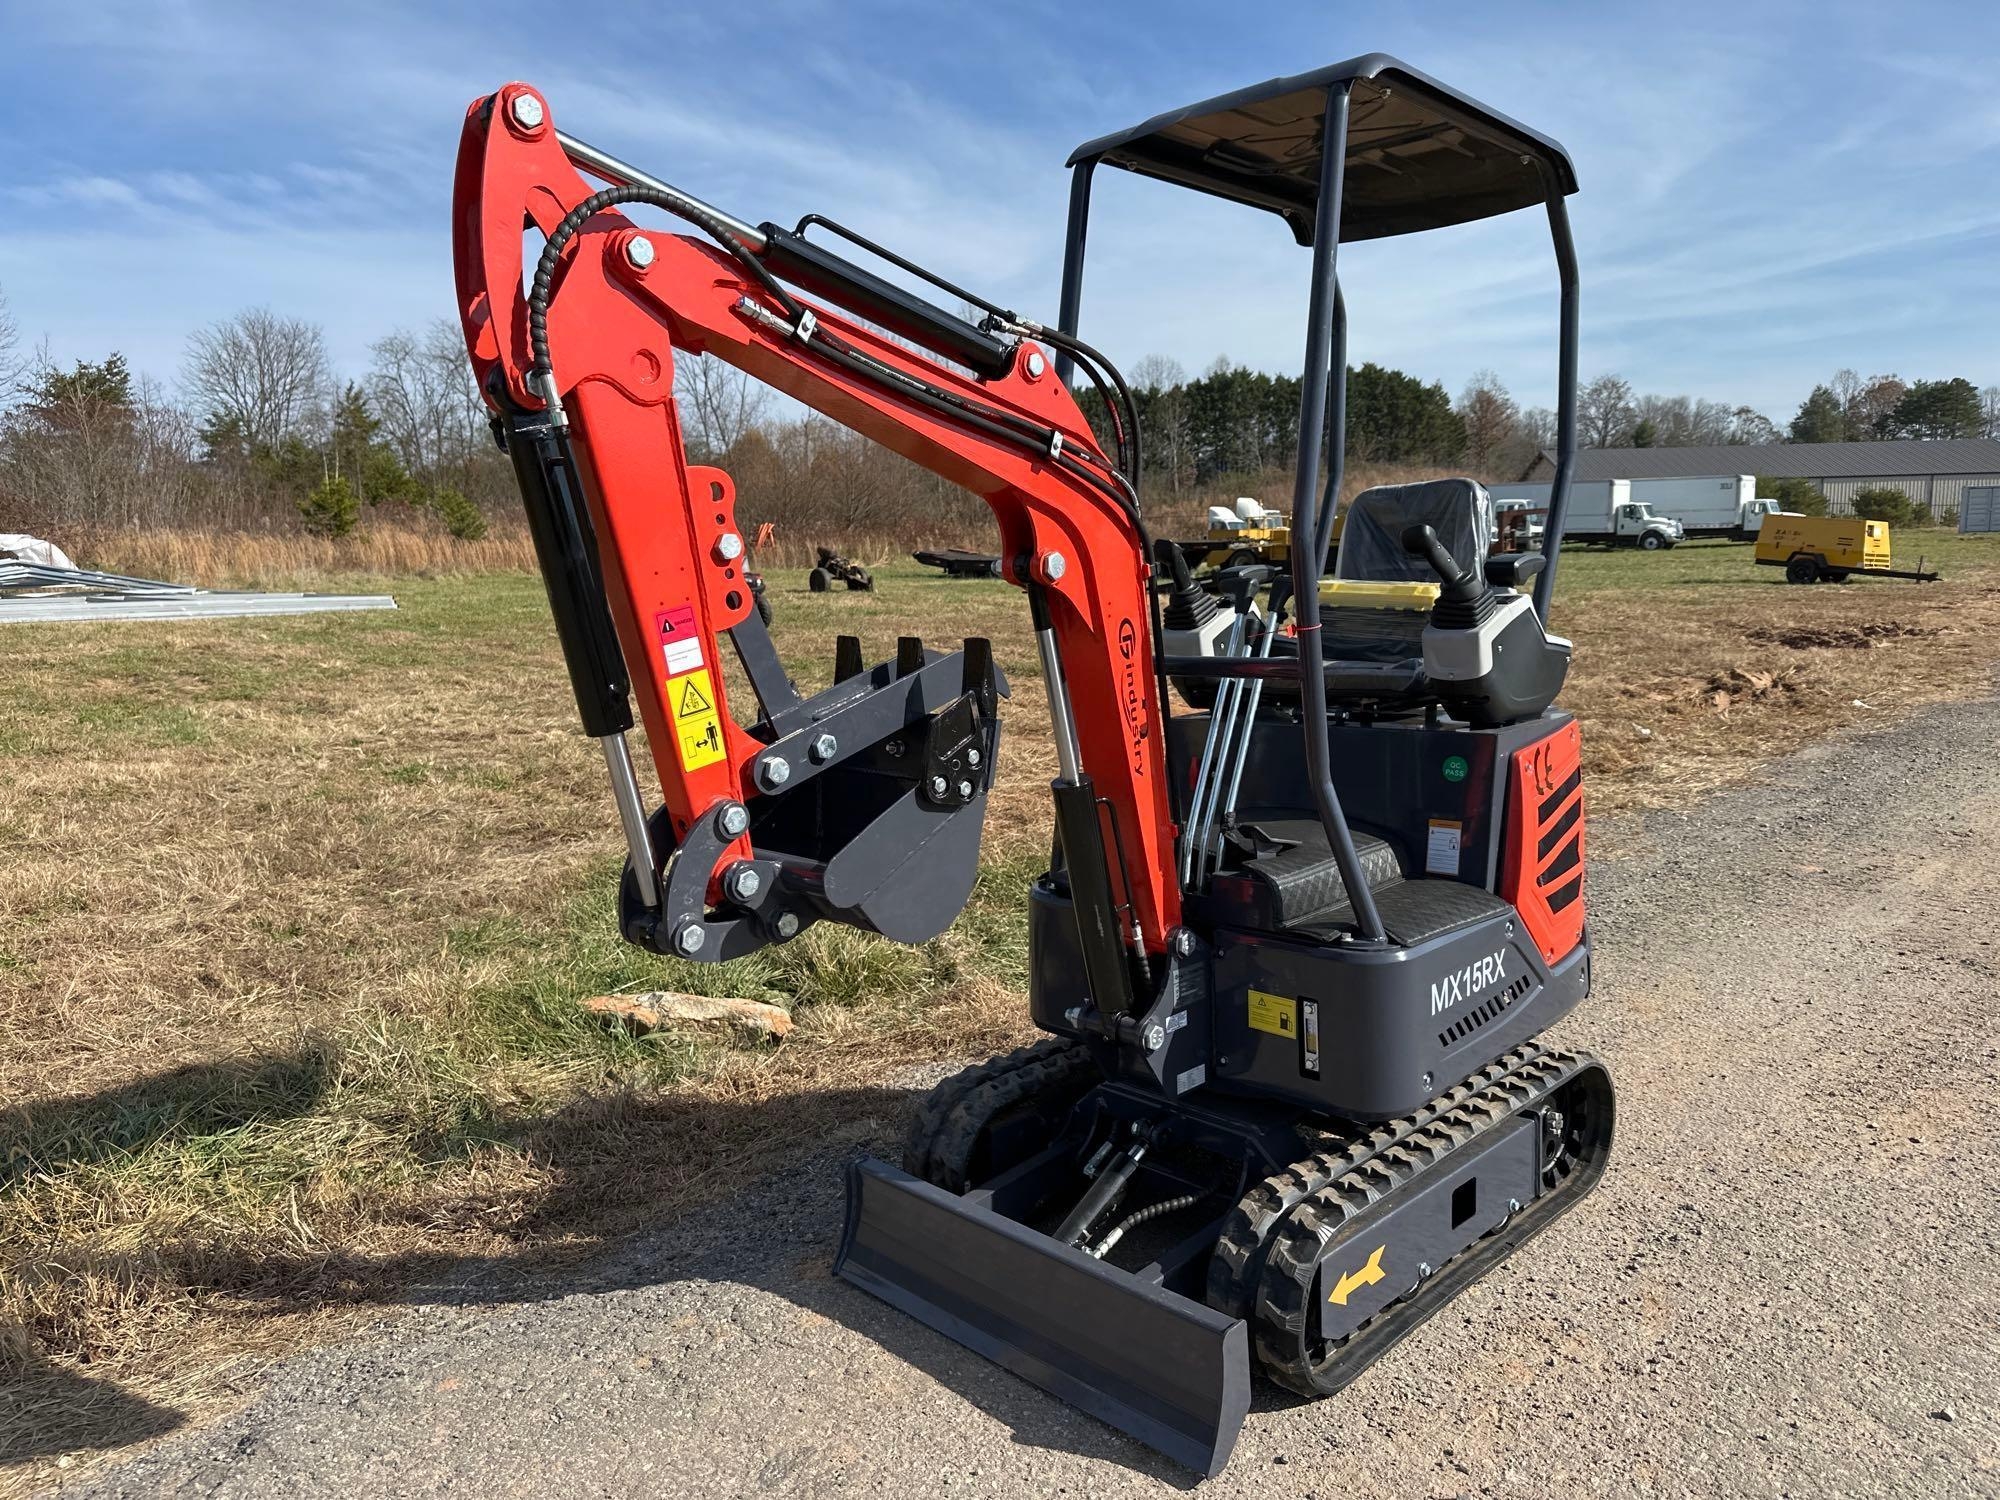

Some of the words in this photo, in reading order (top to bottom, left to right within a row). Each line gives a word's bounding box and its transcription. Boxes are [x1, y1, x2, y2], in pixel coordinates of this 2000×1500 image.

[1449, 761, 1461, 769] QC
[1445, 768, 1465, 777] PASS
[1431, 947, 1506, 1016] MX15RX
